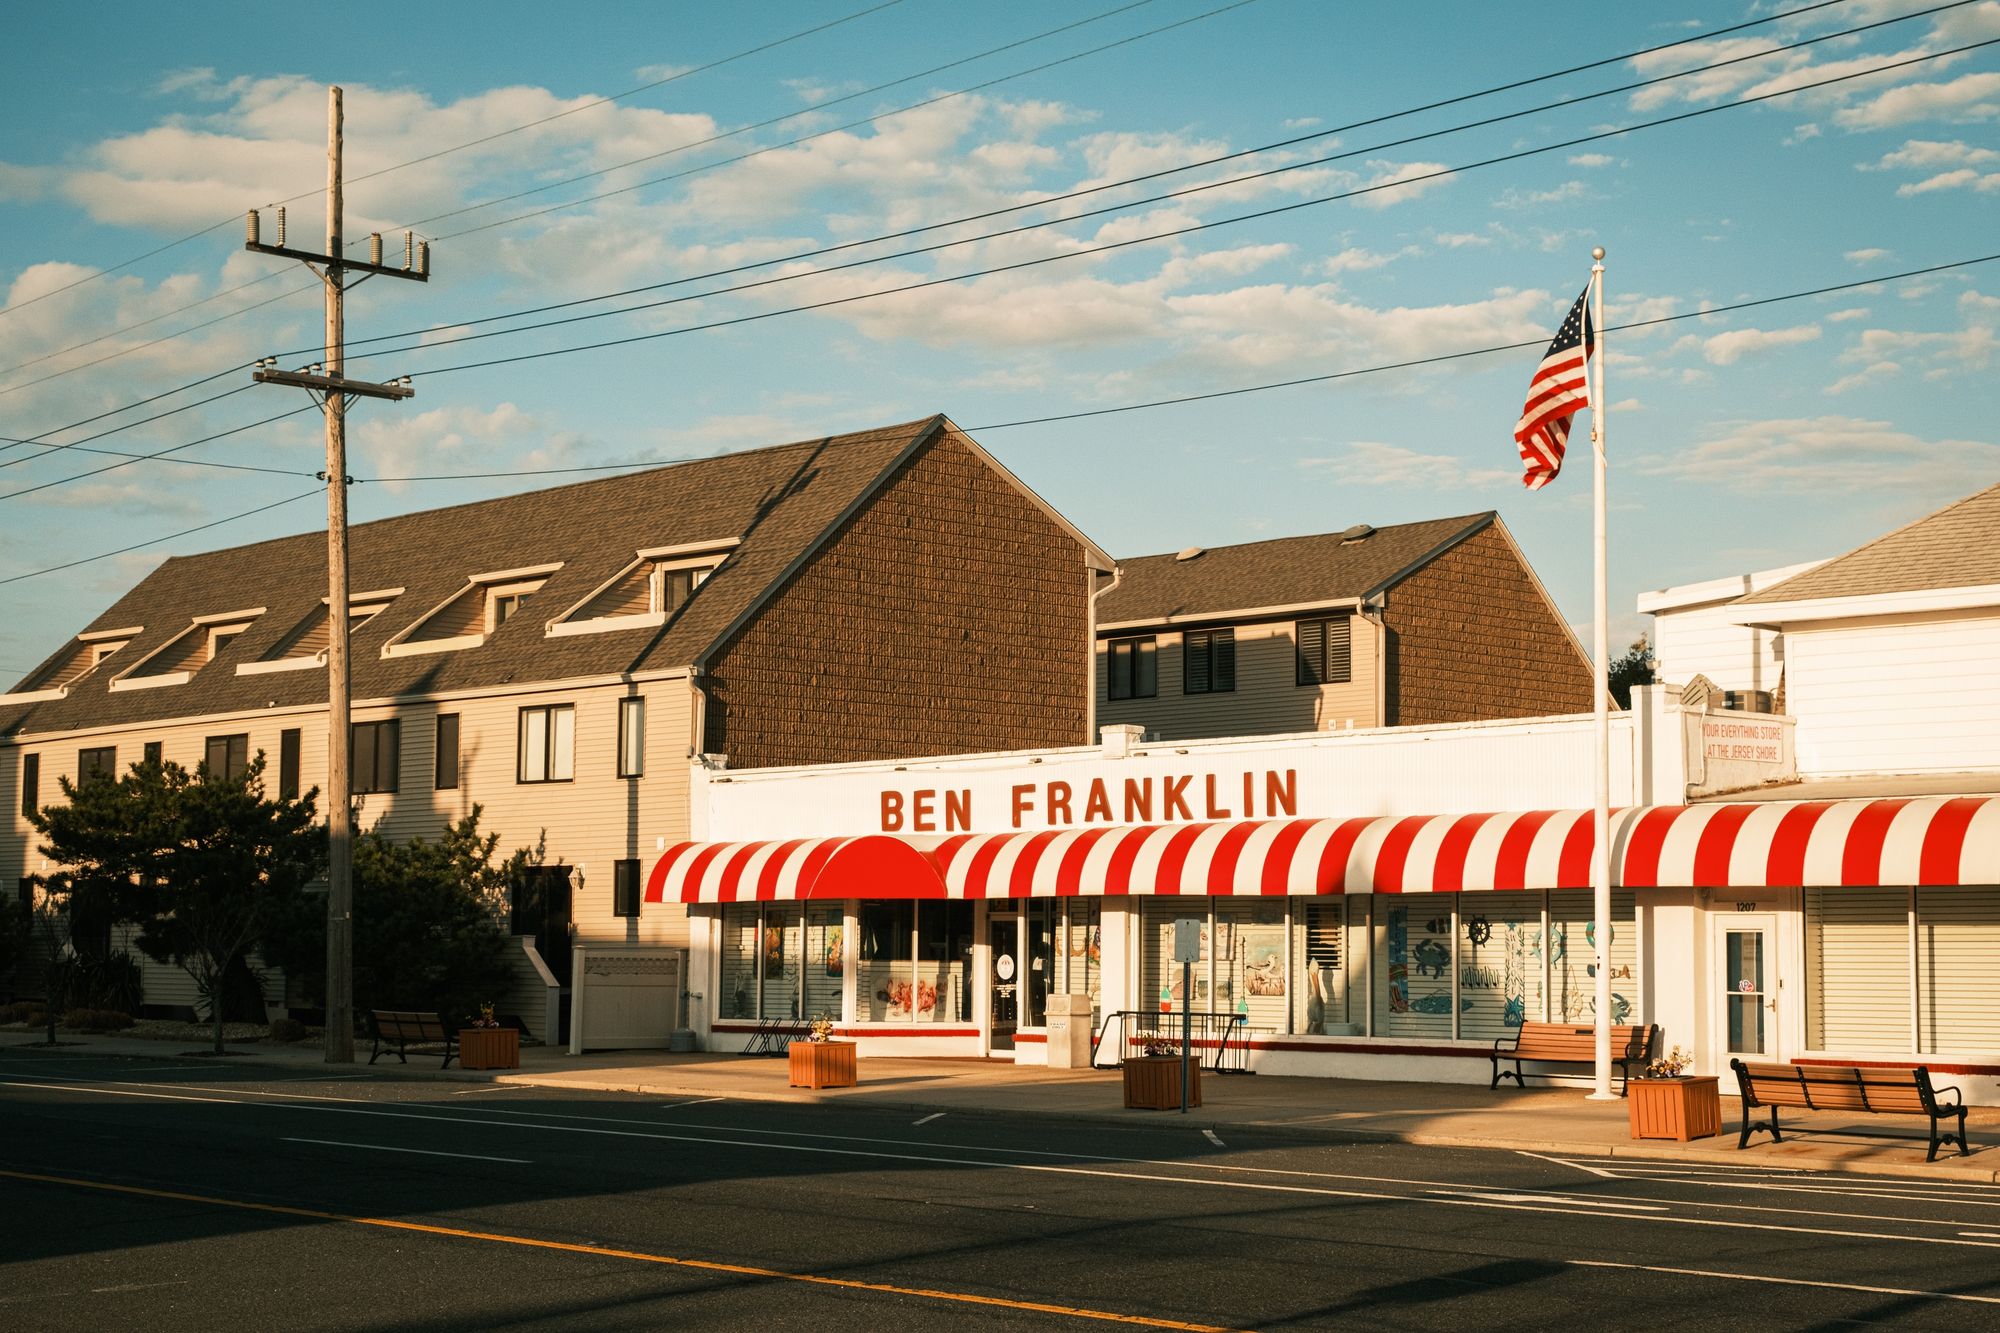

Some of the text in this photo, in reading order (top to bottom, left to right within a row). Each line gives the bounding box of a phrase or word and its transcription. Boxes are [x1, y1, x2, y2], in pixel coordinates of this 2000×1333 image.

[1702, 723, 1781, 740] YOUR EVERYTHING STORE
[1707, 744, 1777, 760] AT THE JERSEY SHORE
[880, 769, 1298, 832] BEN FRANKLIN
[1736, 902, 1756, 912] 1207
